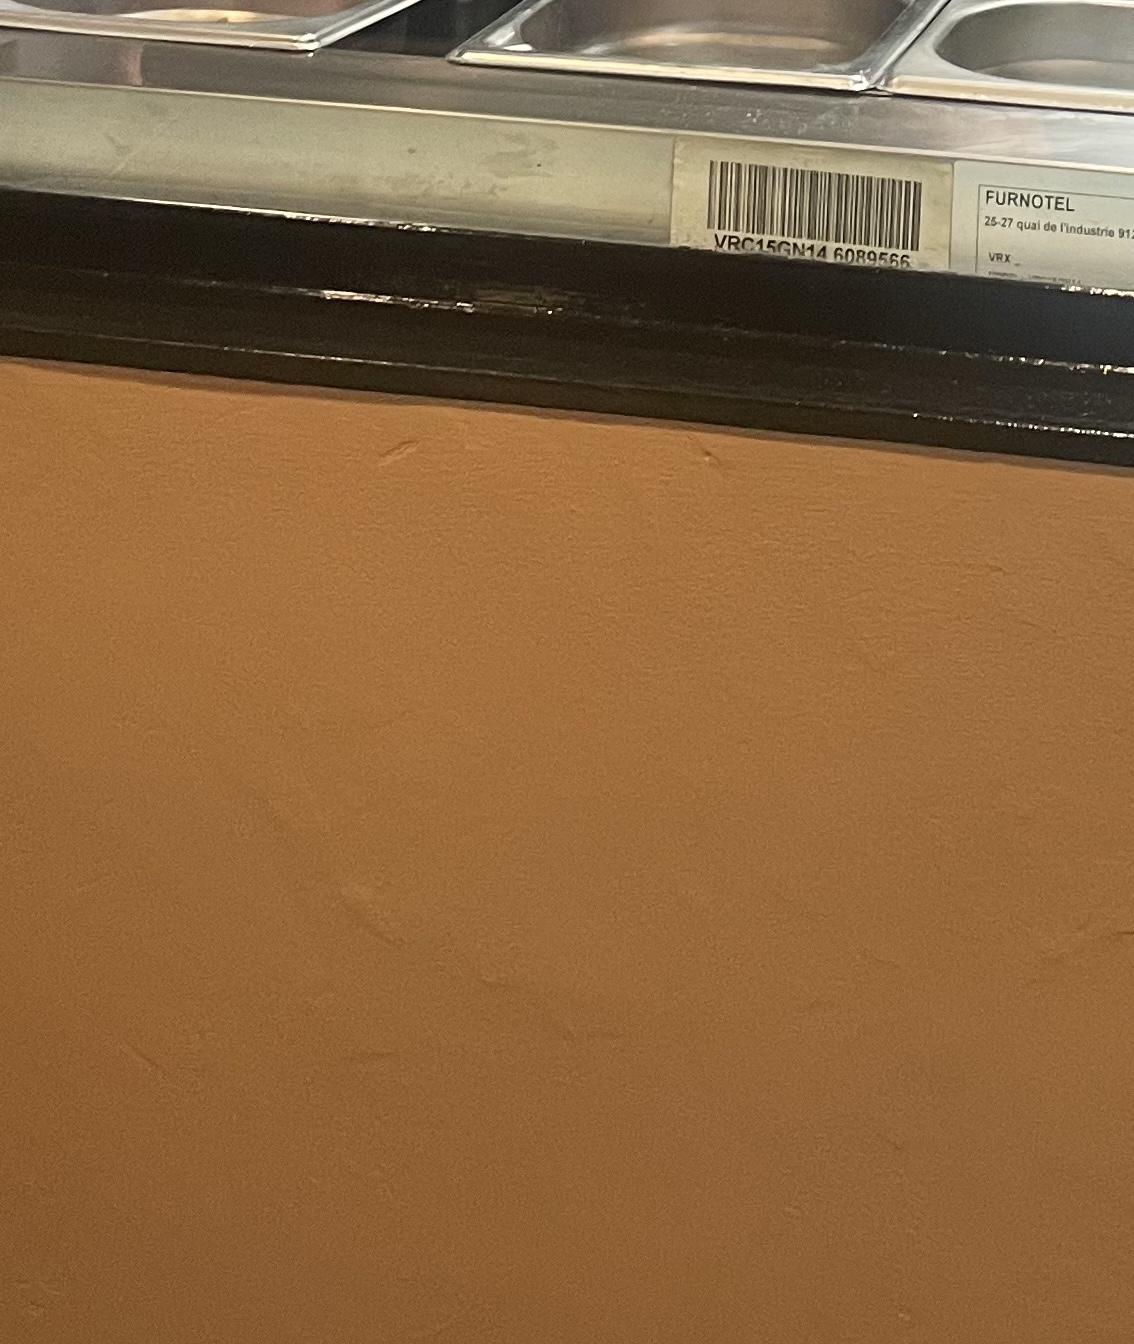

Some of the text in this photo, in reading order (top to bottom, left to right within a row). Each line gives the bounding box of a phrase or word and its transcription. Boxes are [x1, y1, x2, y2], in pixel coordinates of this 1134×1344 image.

[985, 190, 1075, 212] FURNOTEL
[984, 216, 1013, 228] 25-27
[1017, 220, 1041, 232] quai
[1044, 221, 1057, 233] de
[1060, 222, 1115, 238] l'industrie
[988, 252, 1011, 263] VRX
